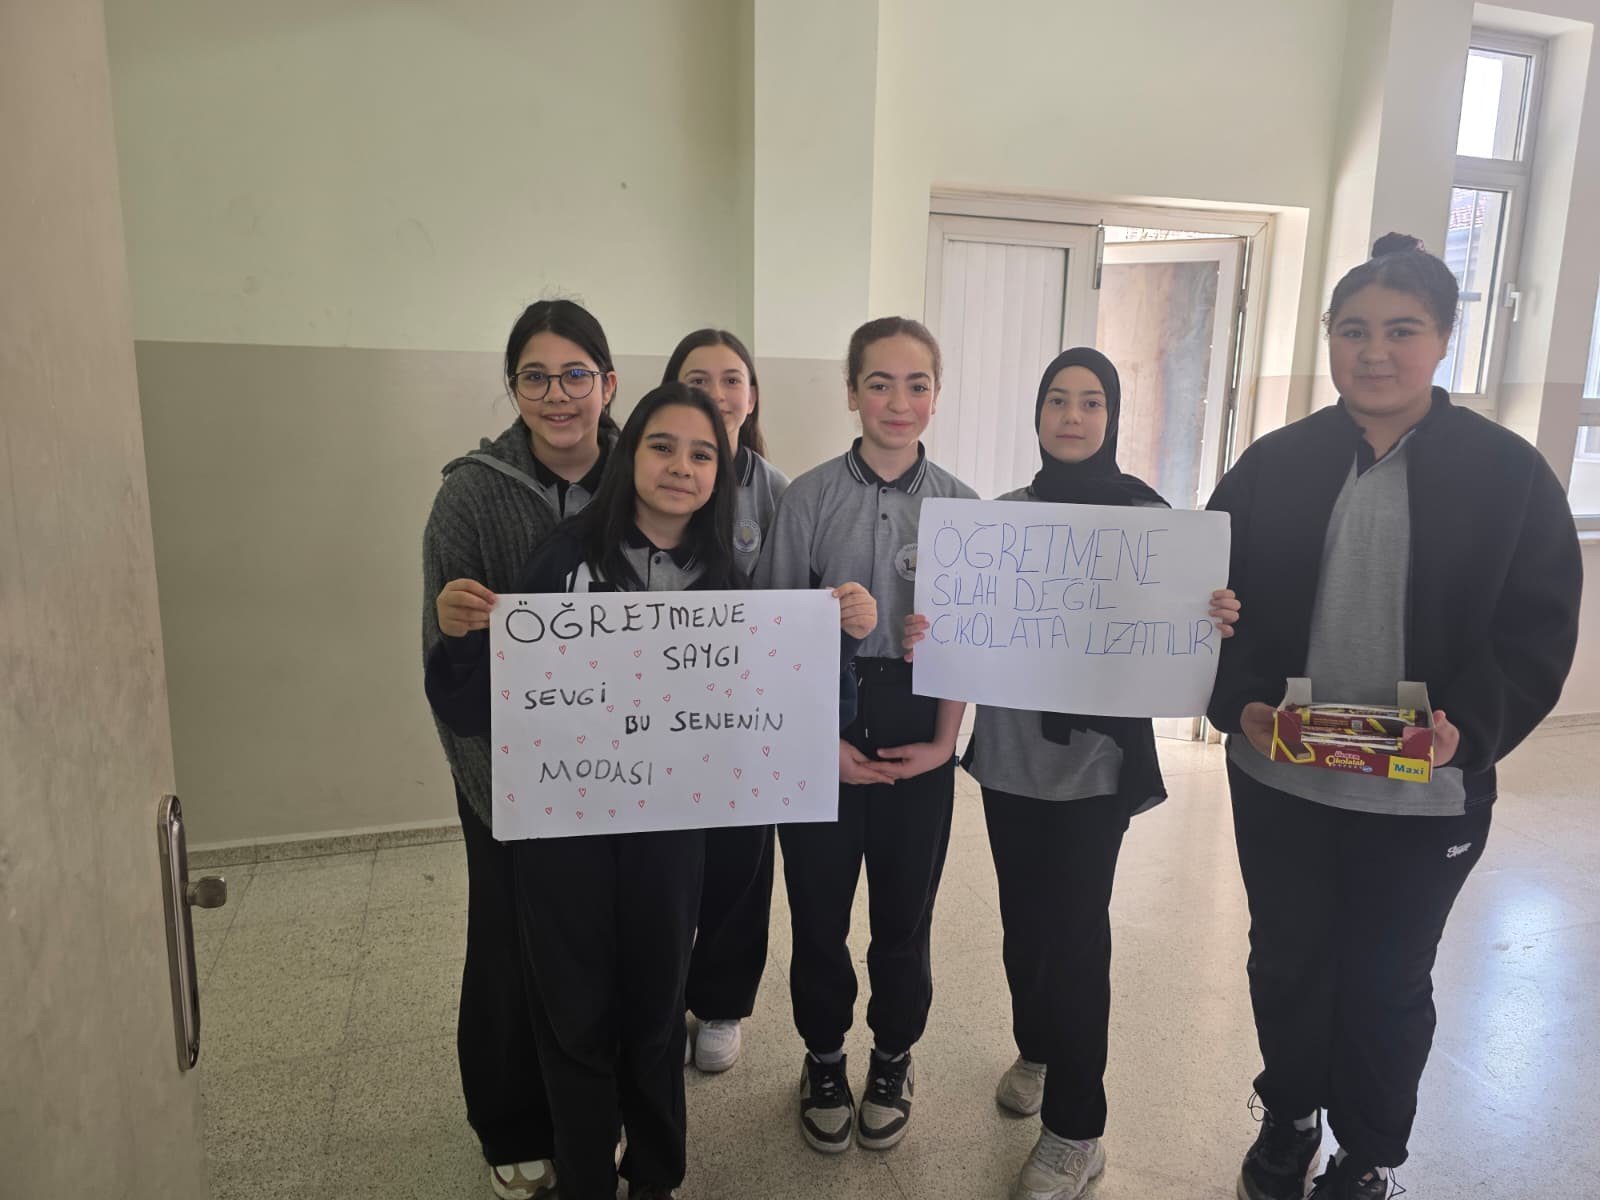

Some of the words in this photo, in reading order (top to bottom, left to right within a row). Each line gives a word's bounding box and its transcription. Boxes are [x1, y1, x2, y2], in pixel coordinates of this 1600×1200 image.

[933, 520, 1169, 585] ÖĞRETMENE
[505, 600, 746, 643] ÖĞRETMENE
[662, 642, 740, 670] SAYGI
[524, 682, 607, 709] SEVGİ
[625, 715, 651, 734] BU
[670, 707, 784, 732] SENENİN
[539, 759, 653, 786] MODASI
[1394, 763, 1424, 775] Maxi
